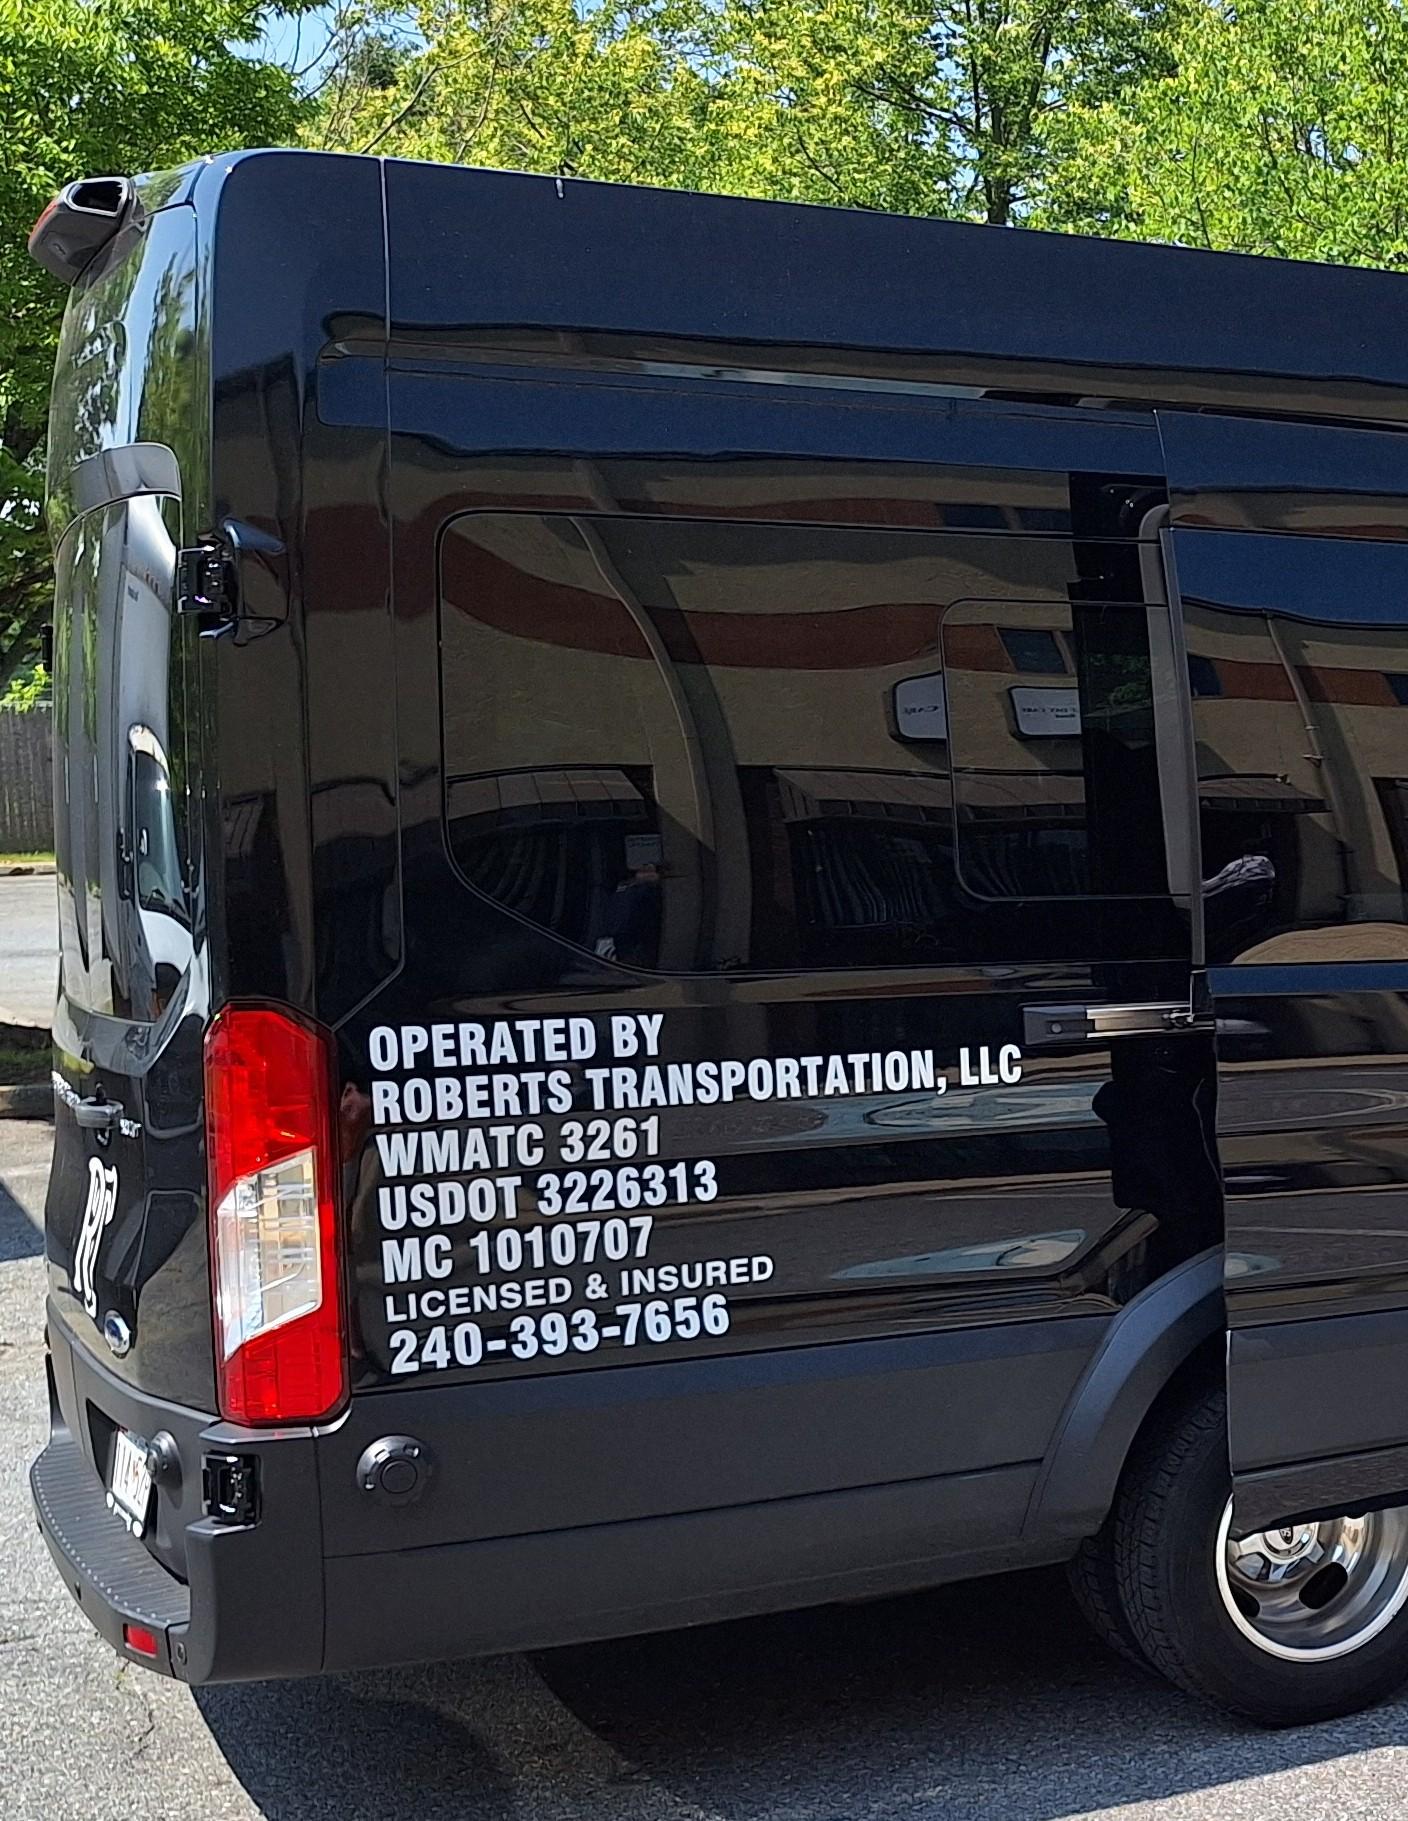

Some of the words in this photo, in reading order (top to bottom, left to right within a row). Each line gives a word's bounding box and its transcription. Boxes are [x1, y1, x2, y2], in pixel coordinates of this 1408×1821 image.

[368, 1018, 597, 1071] OPERATED
[611, 1014, 664, 1058] BY
[371, 1070, 574, 1124] ROBERTS
[585, 1049, 947, 1110] TRANSPORTATION,
[959, 1044, 1023, 1087] LLC
[375, 1124, 545, 1177] WMATC
[560, 1115, 658, 1163] 3261
[378, 1176, 523, 1230] USDOT
[537, 1160, 718, 1216] 3226313
[382, 1234, 453, 1283] MC
[470, 1216, 653, 1274] 1010707
[386, 1277, 572, 1323] LICENSED
[585, 1273, 609, 1300] &
[621, 1256, 774, 1297] INSURED
[390, 1294, 729, 1374] 240-393-7656
